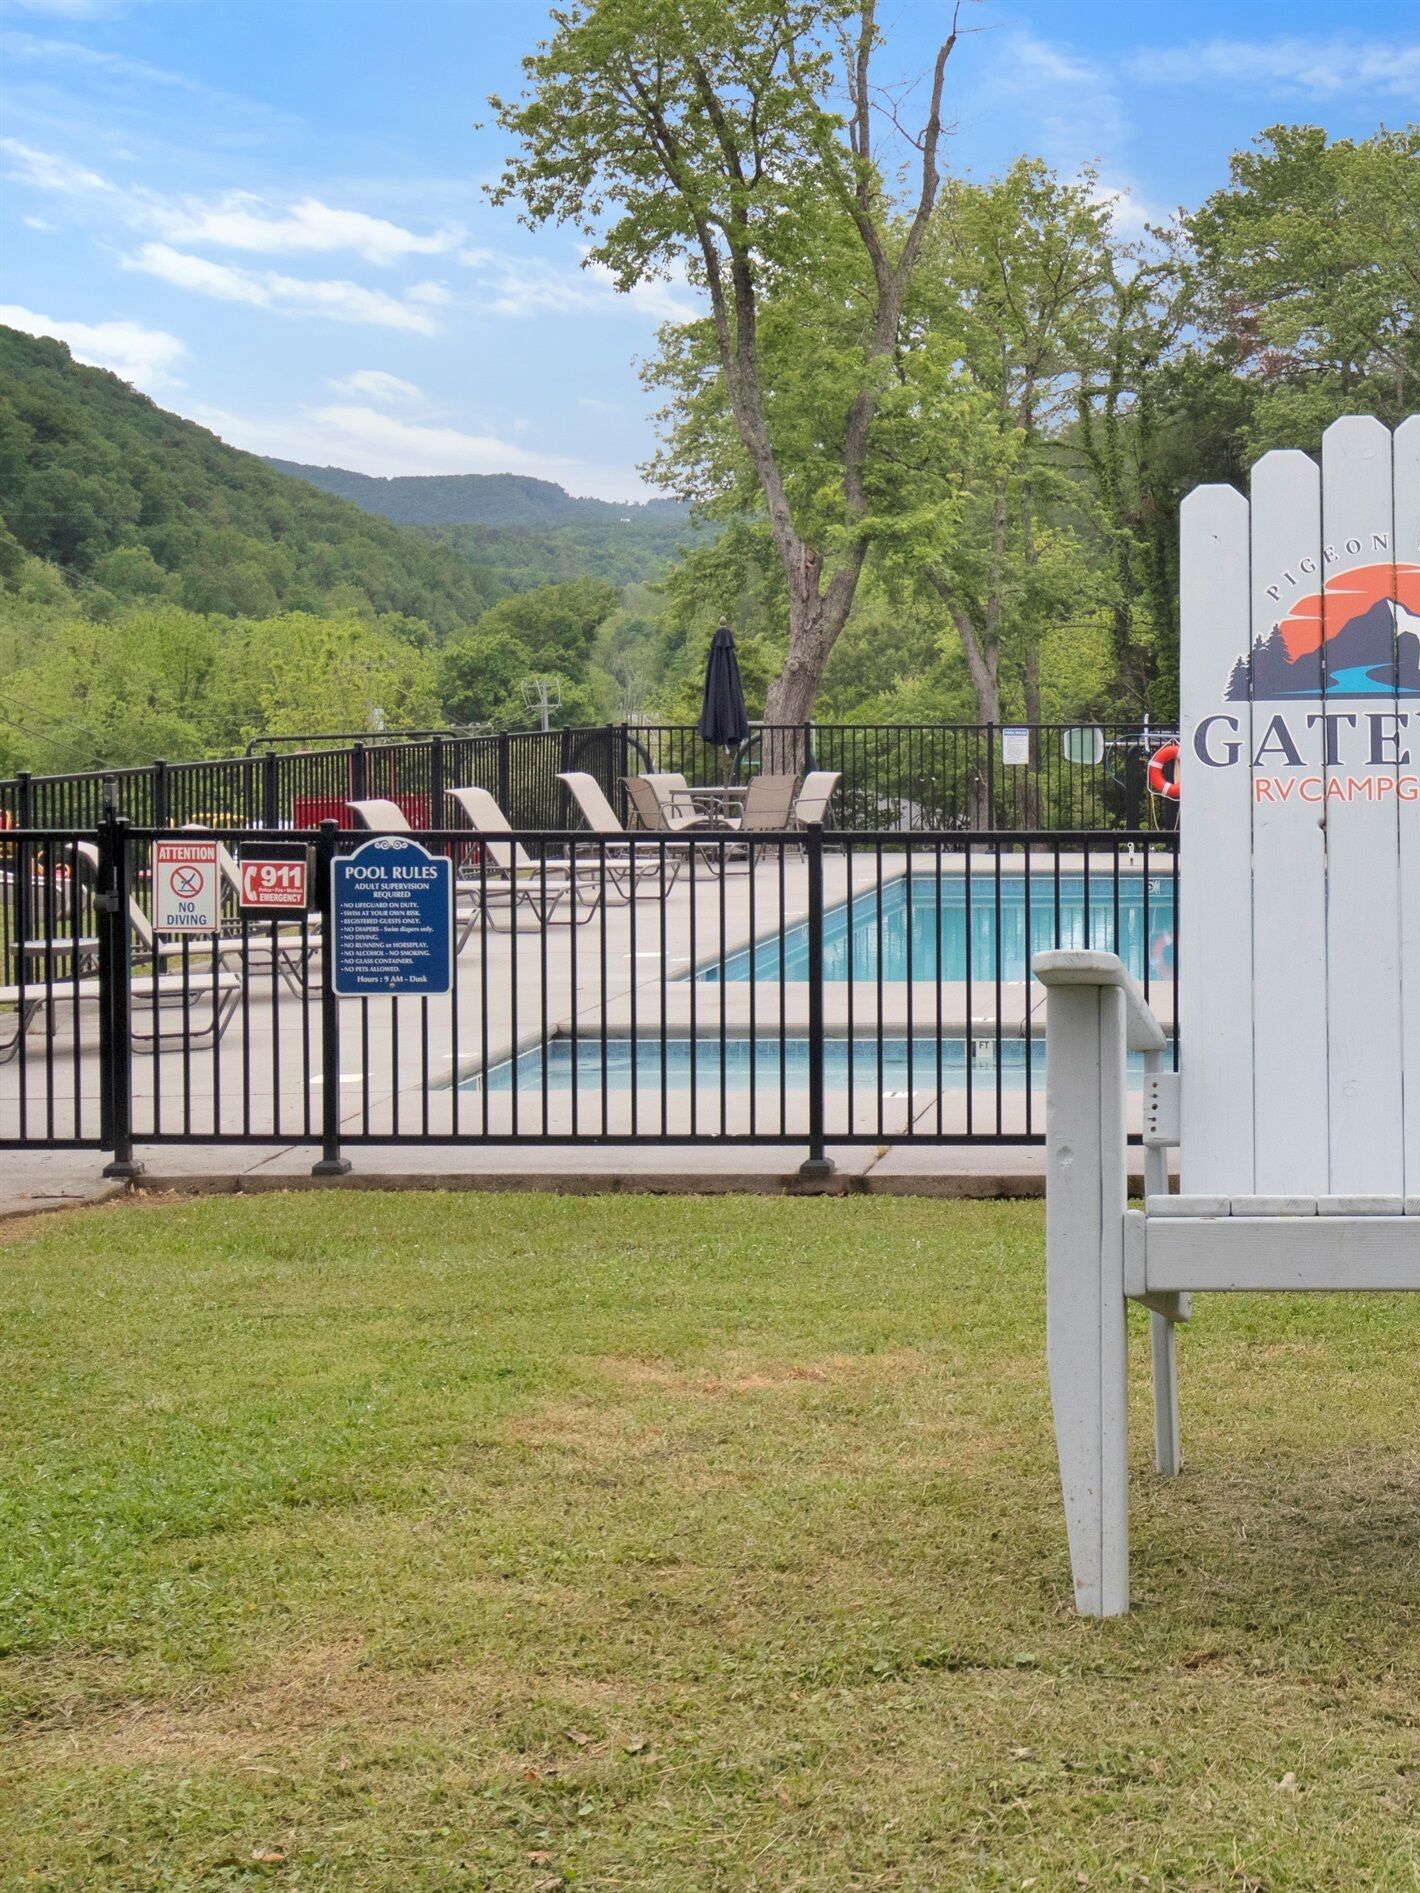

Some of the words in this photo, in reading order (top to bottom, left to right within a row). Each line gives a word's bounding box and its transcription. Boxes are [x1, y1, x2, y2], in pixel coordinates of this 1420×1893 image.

[1265, 533, 1389, 602] PIGEON
[159, 846, 215, 860] ATTENTION
[260, 866, 301, 887] 911
[345, 866, 388, 879] POOL
[392, 866, 438, 879] RULES
[259, 893, 302, 902] EMERGENCY
[373, 891, 411, 899] REQUIRED
[178, 902, 195, 913] NO
[166, 914, 207, 926] DIVING
[409, 974, 428, 982] Dusk
